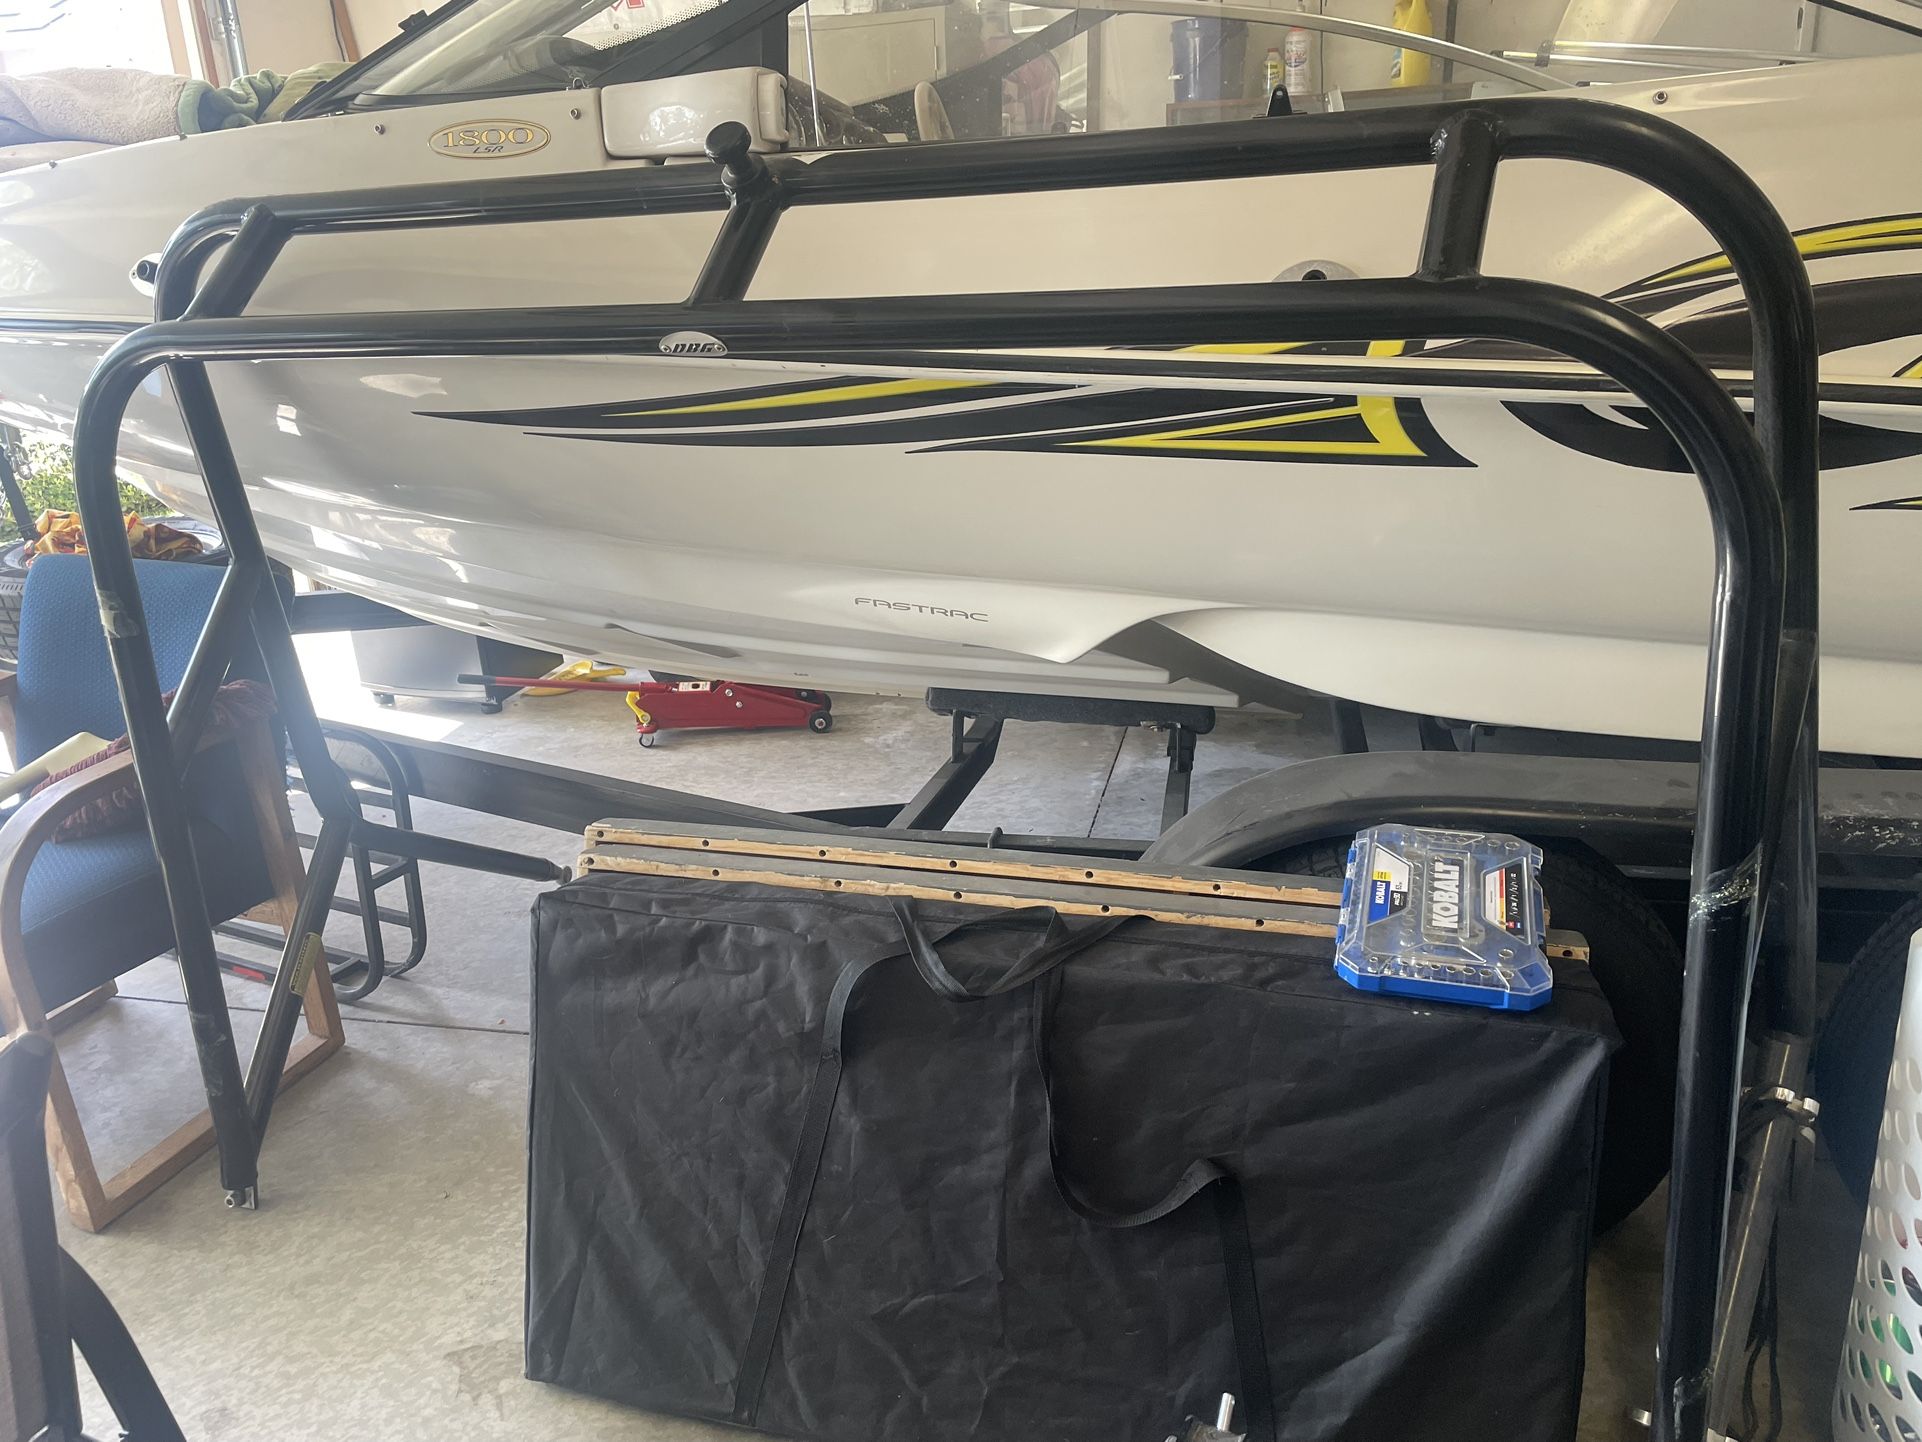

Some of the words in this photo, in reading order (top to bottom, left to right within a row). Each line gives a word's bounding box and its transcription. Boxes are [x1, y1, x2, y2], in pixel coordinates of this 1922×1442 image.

[443, 127, 534, 147] 1800
[854, 597, 989, 623] FASTRAC
[1375, 881, 1386, 904] KOBALT
[1432, 861, 1460, 928] KOBALT
